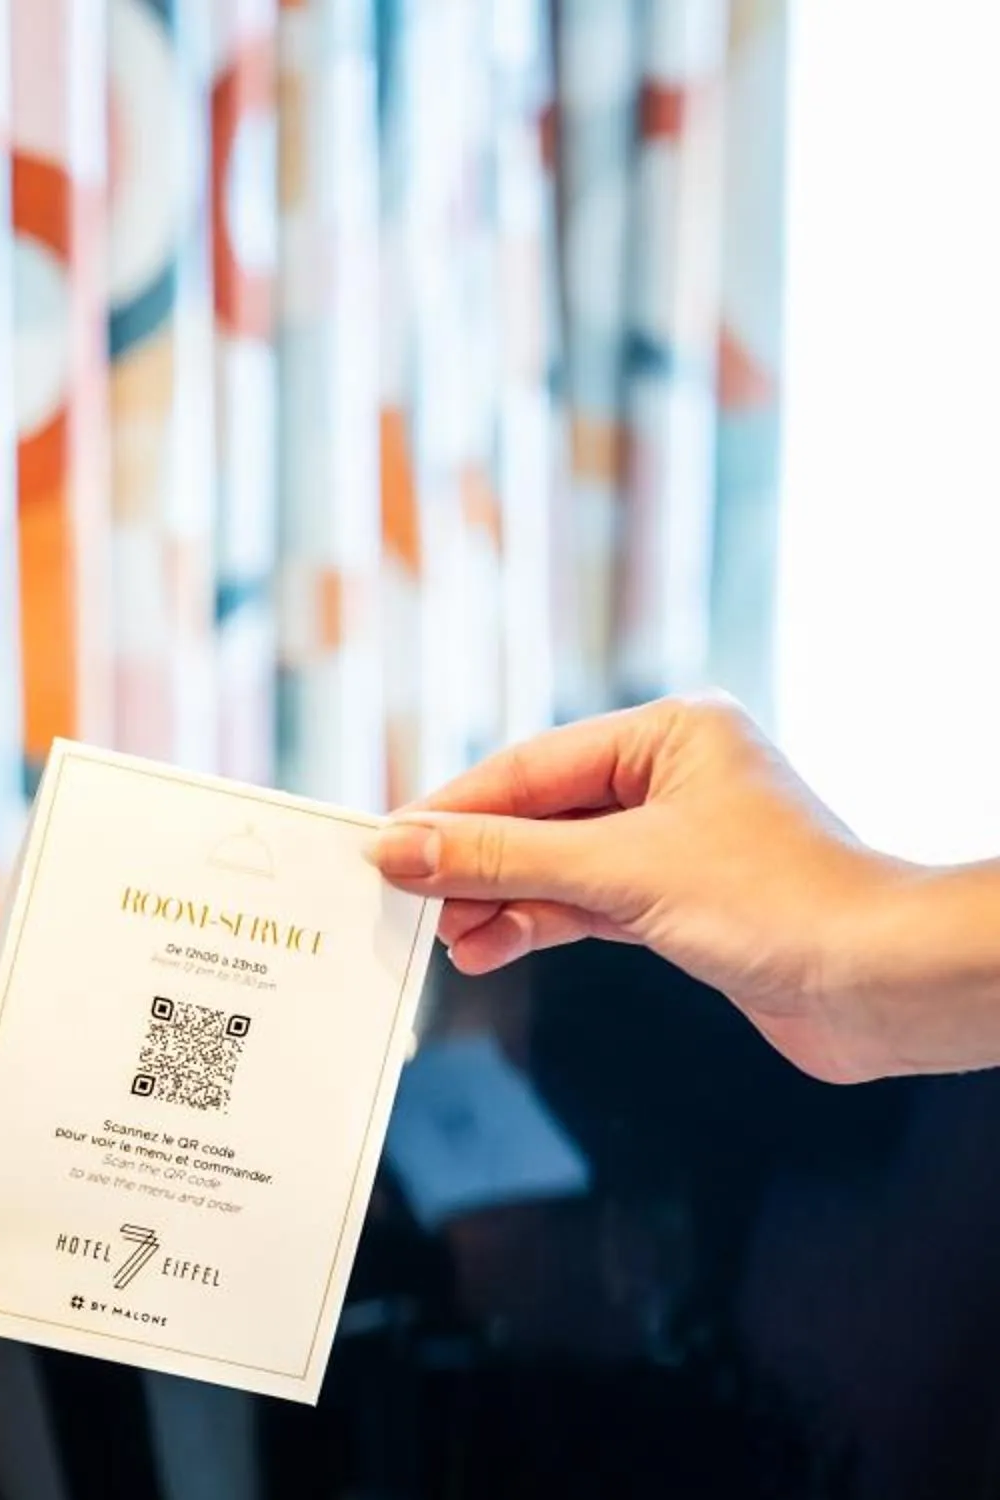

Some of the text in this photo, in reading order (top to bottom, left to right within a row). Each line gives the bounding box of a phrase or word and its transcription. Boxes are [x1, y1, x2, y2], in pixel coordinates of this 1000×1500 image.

[120, 886, 325, 955] ROOM-SERVICE
[165, 943, 182, 956] De
[55, 1127, 273, 1185] pour voir le menu et commander.
[103, 1119, 235, 1159] Scannez le QR code
[69, 1167, 85, 1179] to
[113, 1177, 136, 1191] the
[137, 1184, 175, 1200] menu
[177, 1193, 206, 1207] and
[102, 1153, 221, 1190] Scan the QR code
[56, 1223, 221, 1290] HOTEL 7 EIFFEL
[90, 1301, 168, 1328] BY MALONE
